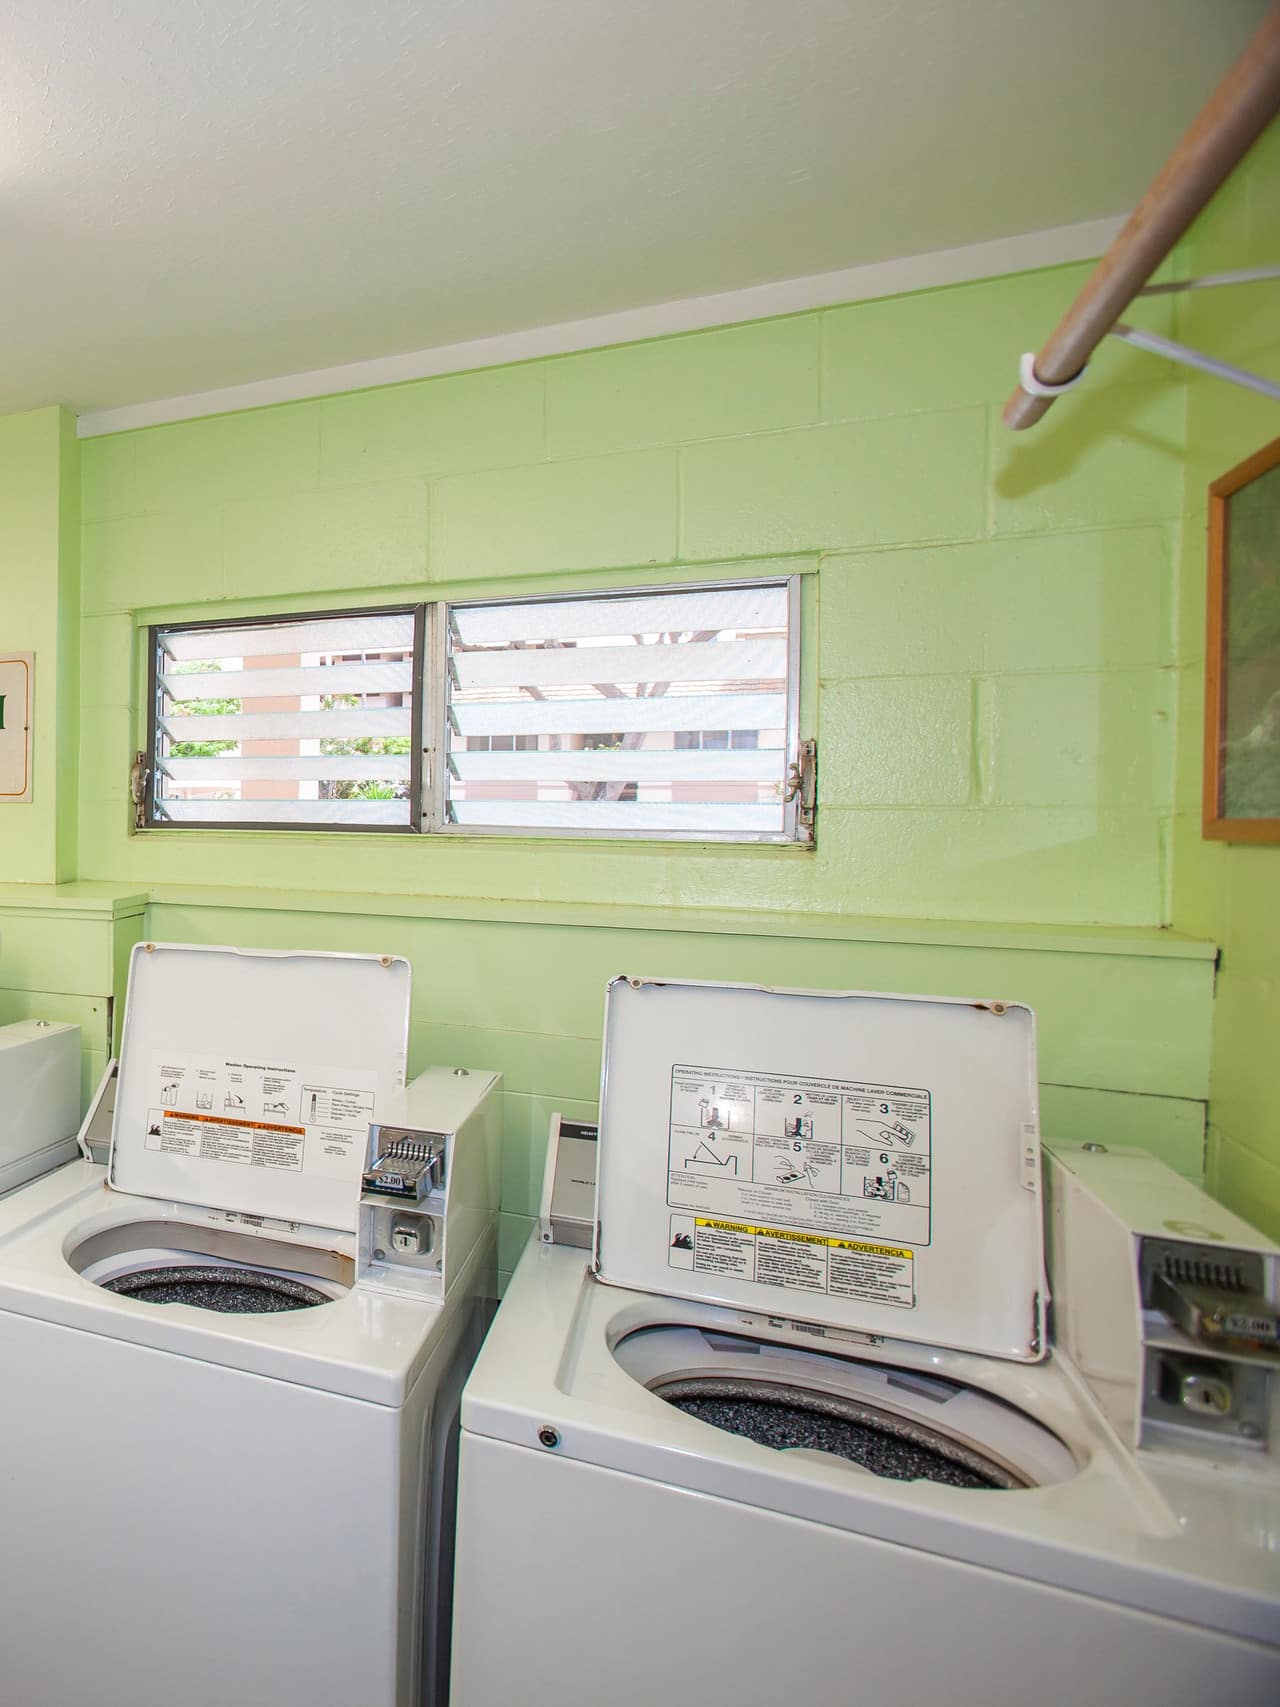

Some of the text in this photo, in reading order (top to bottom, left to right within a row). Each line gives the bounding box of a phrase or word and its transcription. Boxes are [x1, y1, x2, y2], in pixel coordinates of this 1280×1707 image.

[710, 1085, 716, 1095] 1
[793, 1094, 802, 1105] 2
[880, 1103, 889, 1114] 3
[708, 1131, 716, 1142] 4
[793, 1141, 802, 1152] 5
[880, 1153, 889, 1164] 6
[379, 1175, 401, 1186] $2.00
[712, 1221, 905, 1258] WARNING AVERTISSEMENT ADVERTENCIA
